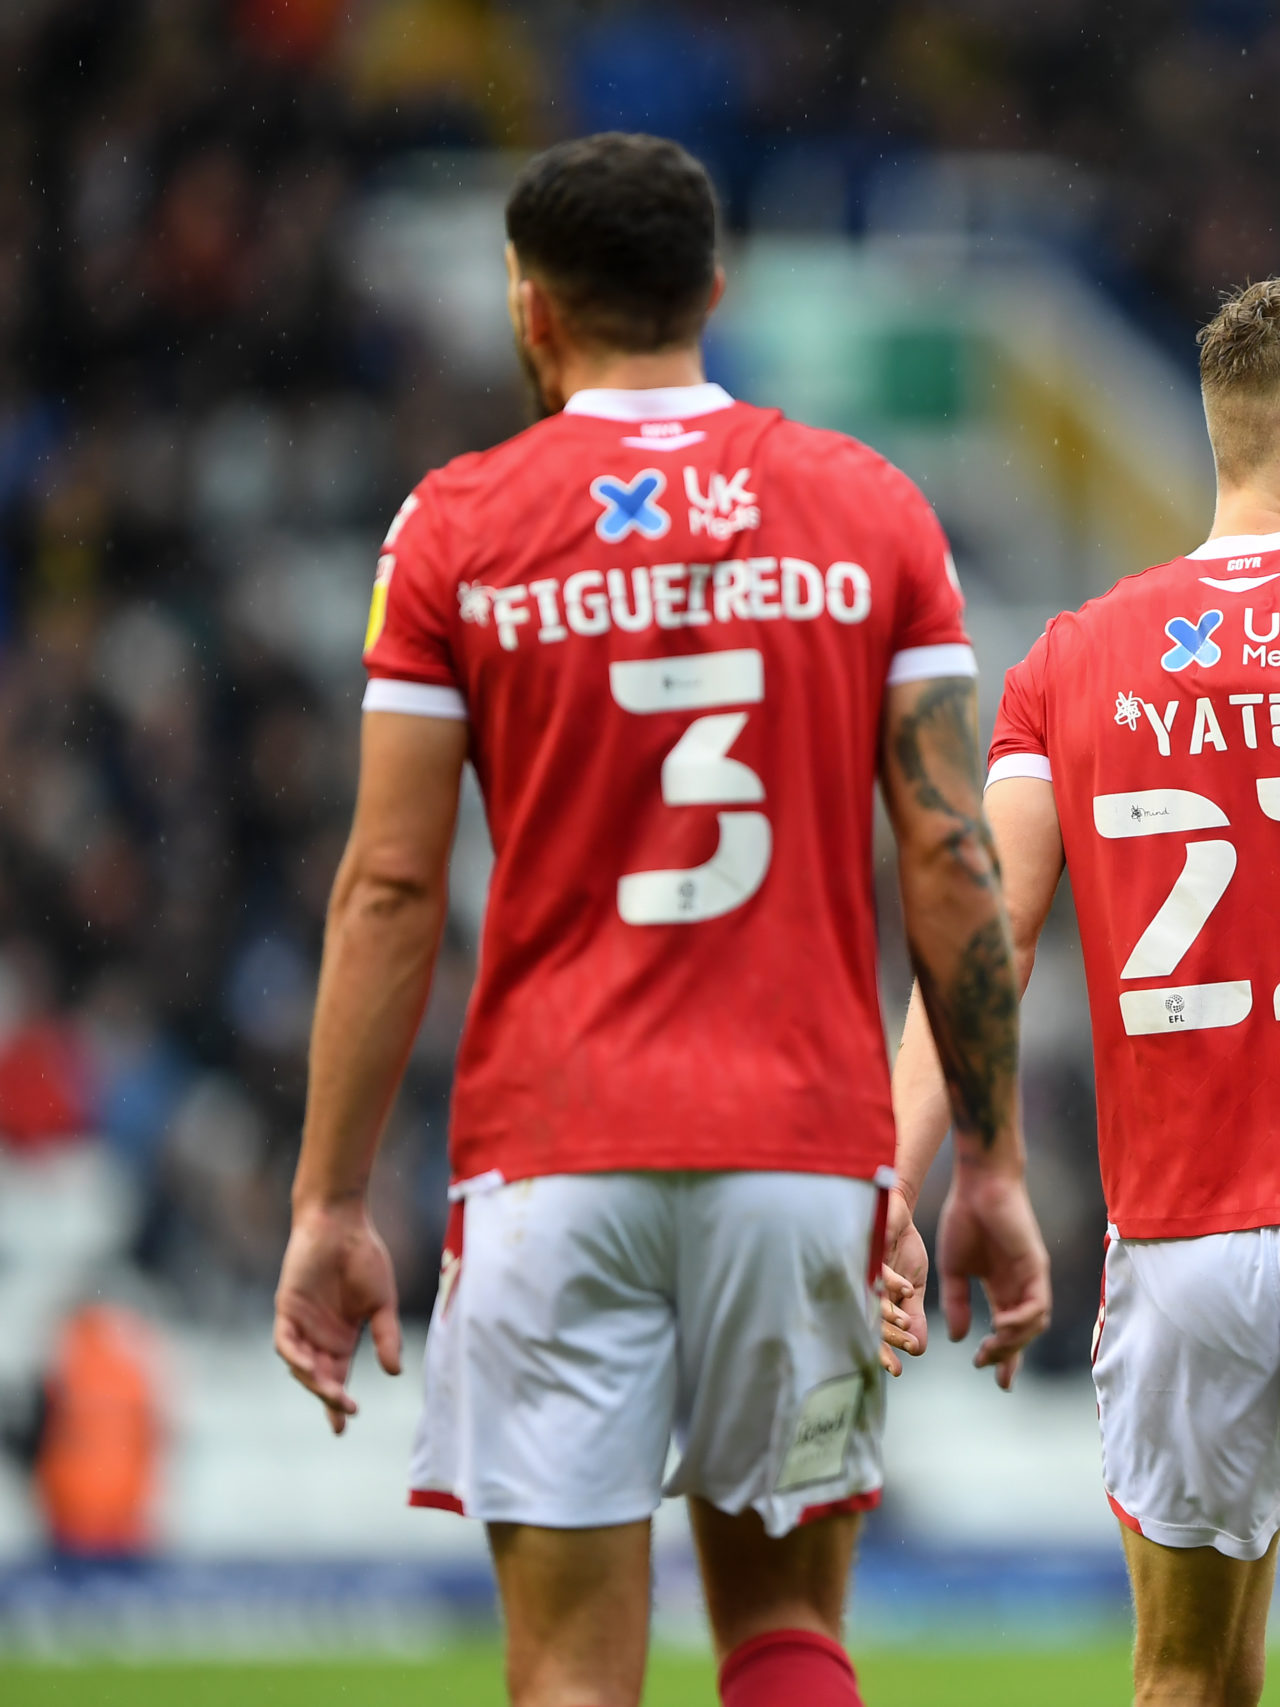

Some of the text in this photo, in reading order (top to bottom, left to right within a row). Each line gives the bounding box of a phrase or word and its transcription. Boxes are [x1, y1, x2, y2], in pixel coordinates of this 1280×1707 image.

[683, 466, 757, 514] UK
[492, 557, 871, 651] FIGUEIREDO
[609, 649, 772, 926] 3
[1168, 1015, 1185, 1023] EFL
